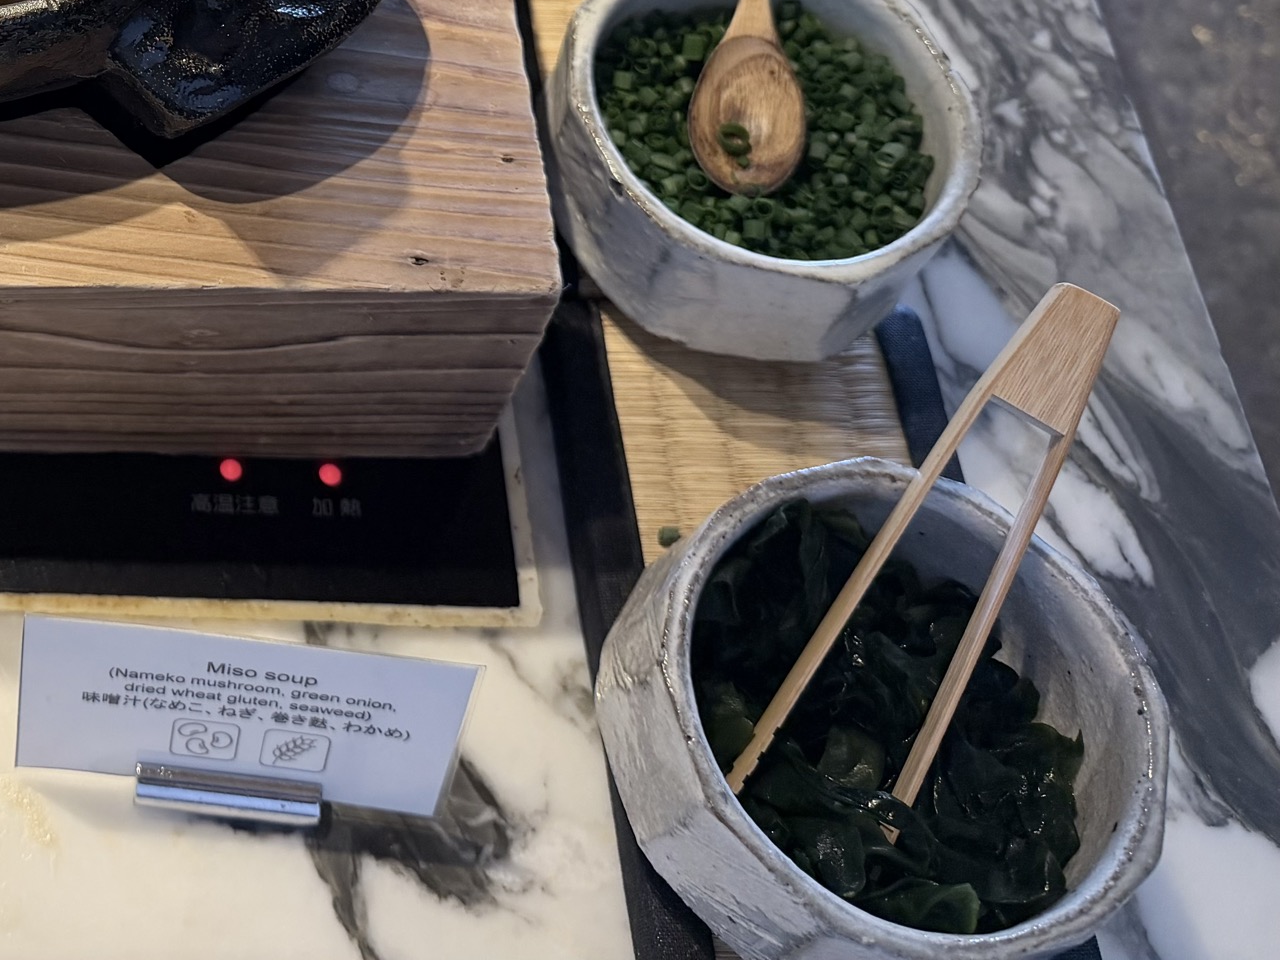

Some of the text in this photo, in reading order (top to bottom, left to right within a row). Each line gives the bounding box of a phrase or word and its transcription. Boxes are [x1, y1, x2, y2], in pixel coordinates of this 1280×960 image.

[108, 666, 397, 713] (Nameko mushroom, green onion,
[206, 661, 318, 688] Miso soup
[124, 682, 372, 722] dried wheat gluten, seaweed)
